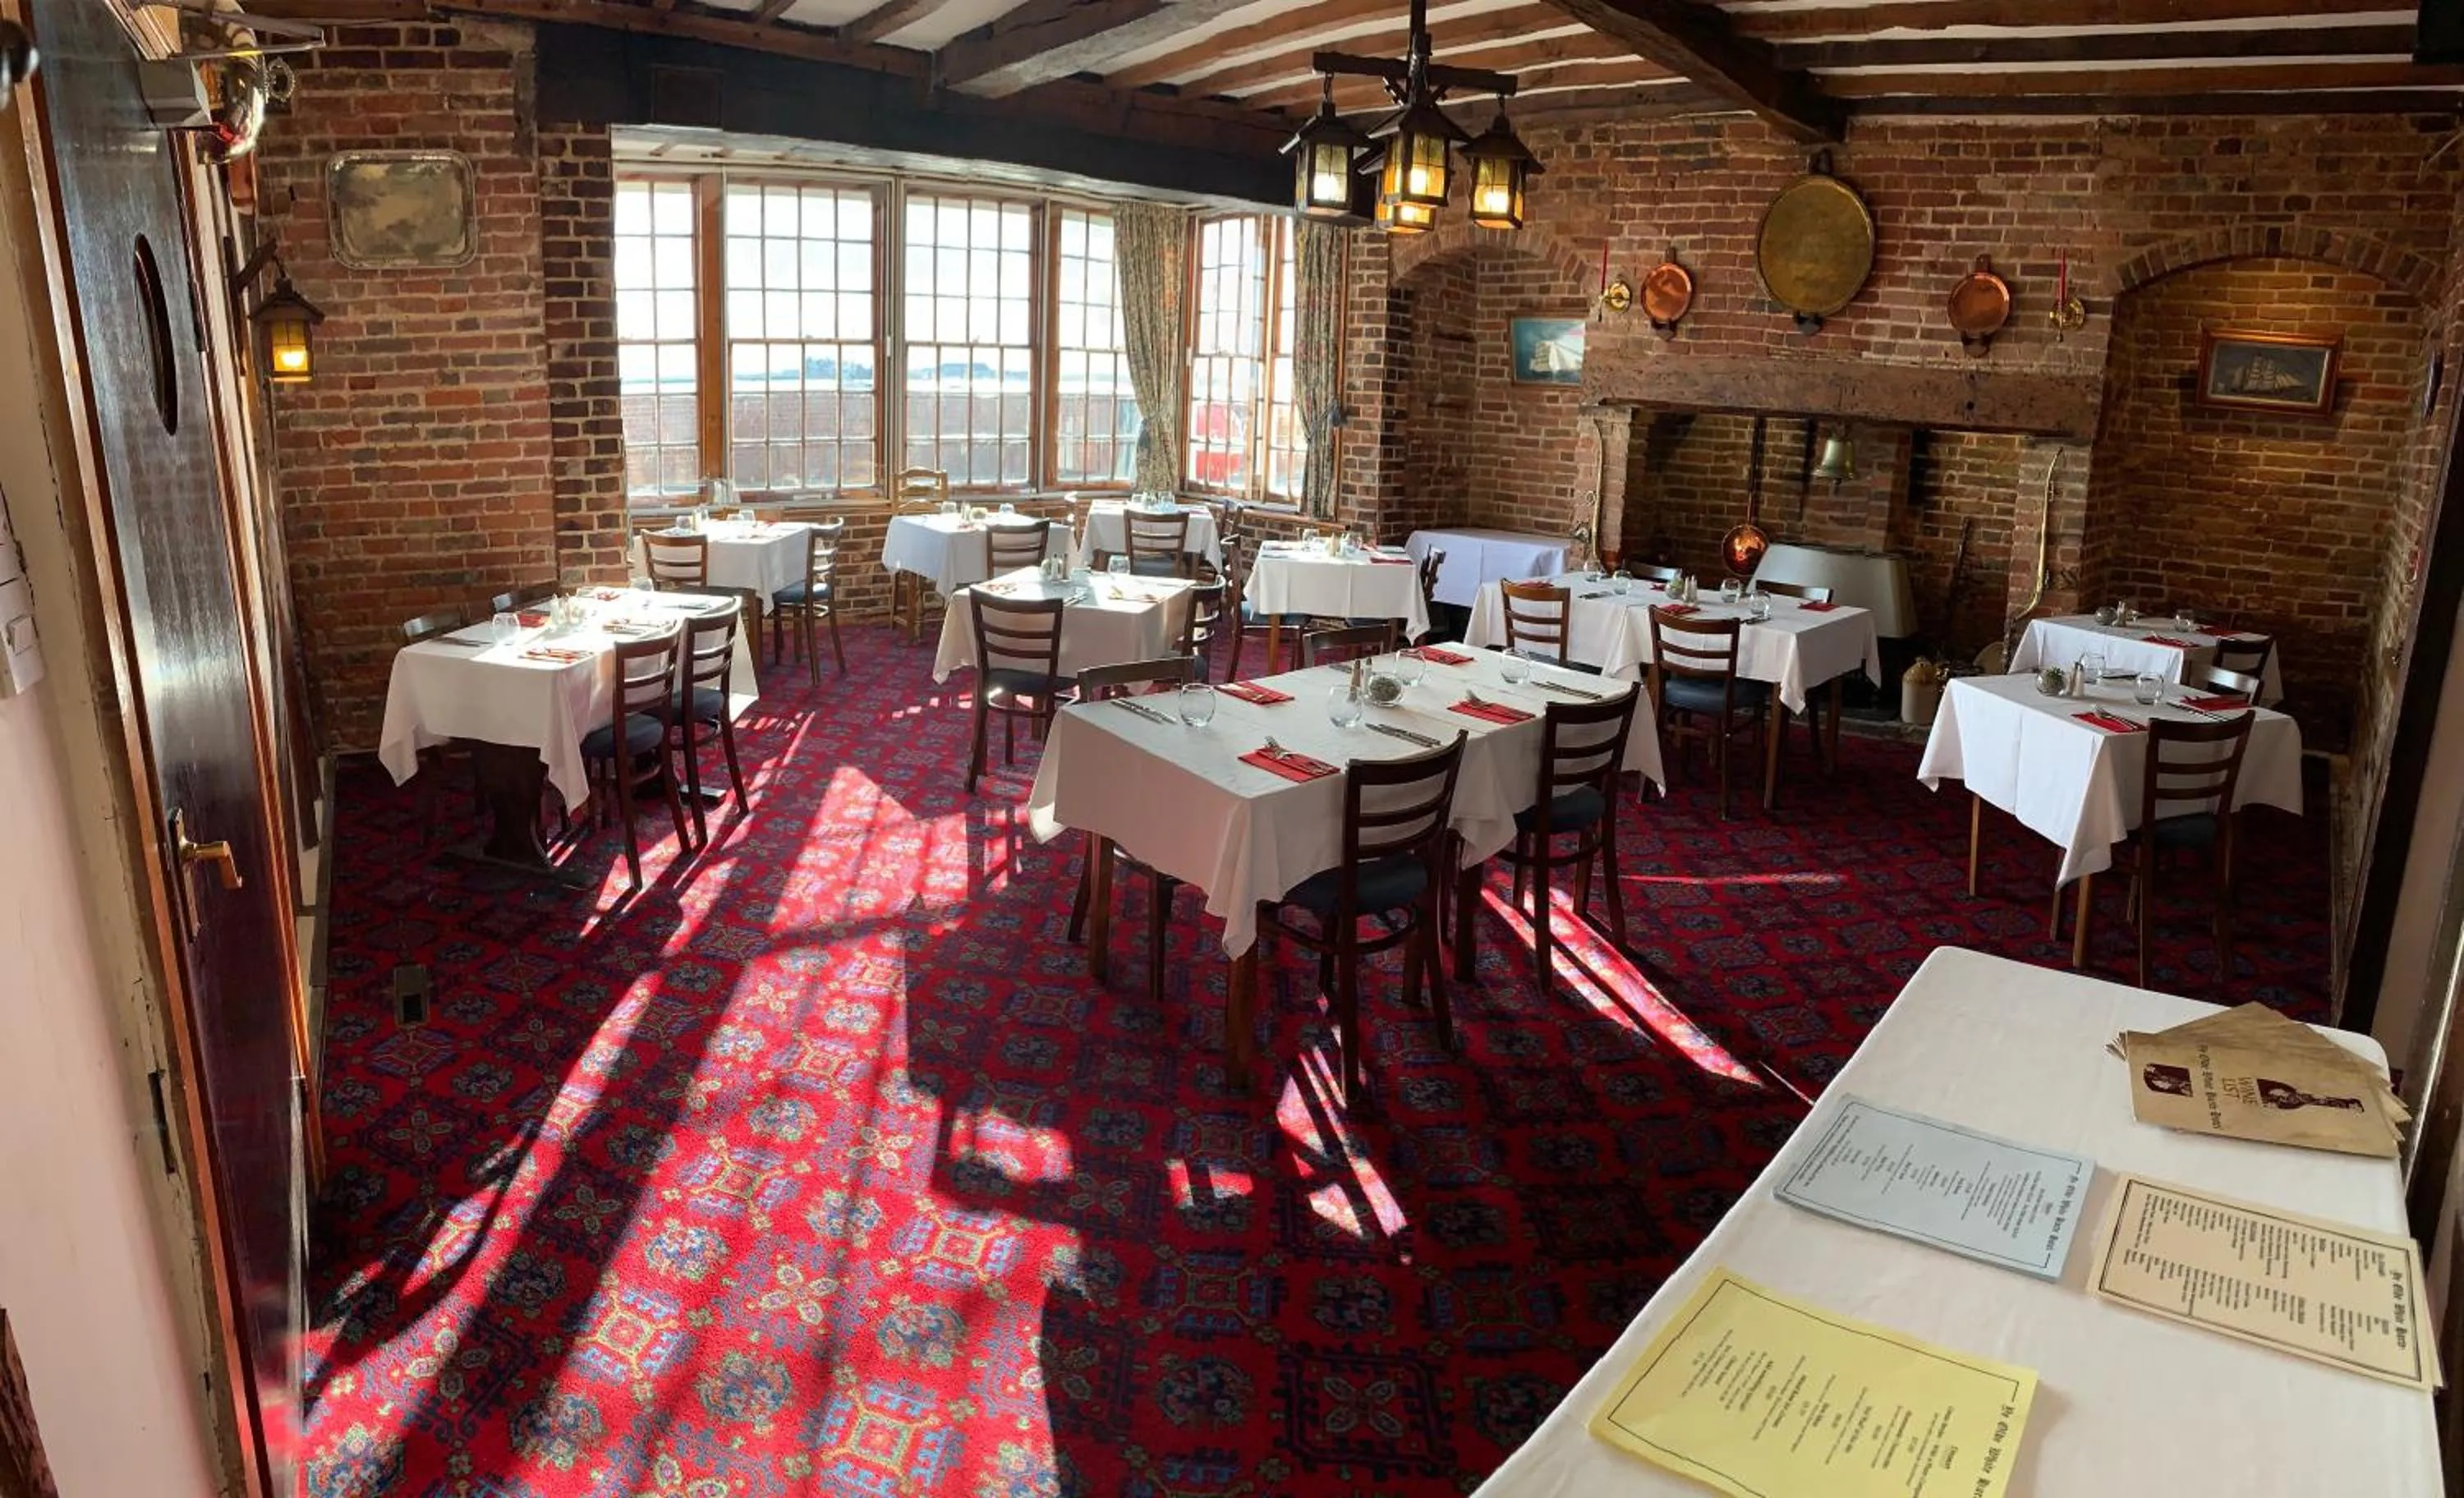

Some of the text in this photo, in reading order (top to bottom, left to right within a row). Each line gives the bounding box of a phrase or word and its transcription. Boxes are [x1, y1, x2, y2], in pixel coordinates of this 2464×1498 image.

[2221, 1077, 2238, 1099] LIST
[2237, 1077, 2257, 1105] WINE
[2393, 1302, 2407, 1325] White
[2394, 1325, 2409, 1349] Harte
[1999, 1404, 2015, 1418] Ye
[1991, 1420, 2009, 1444] Olde
[1980, 1445, 2002, 1475] White
